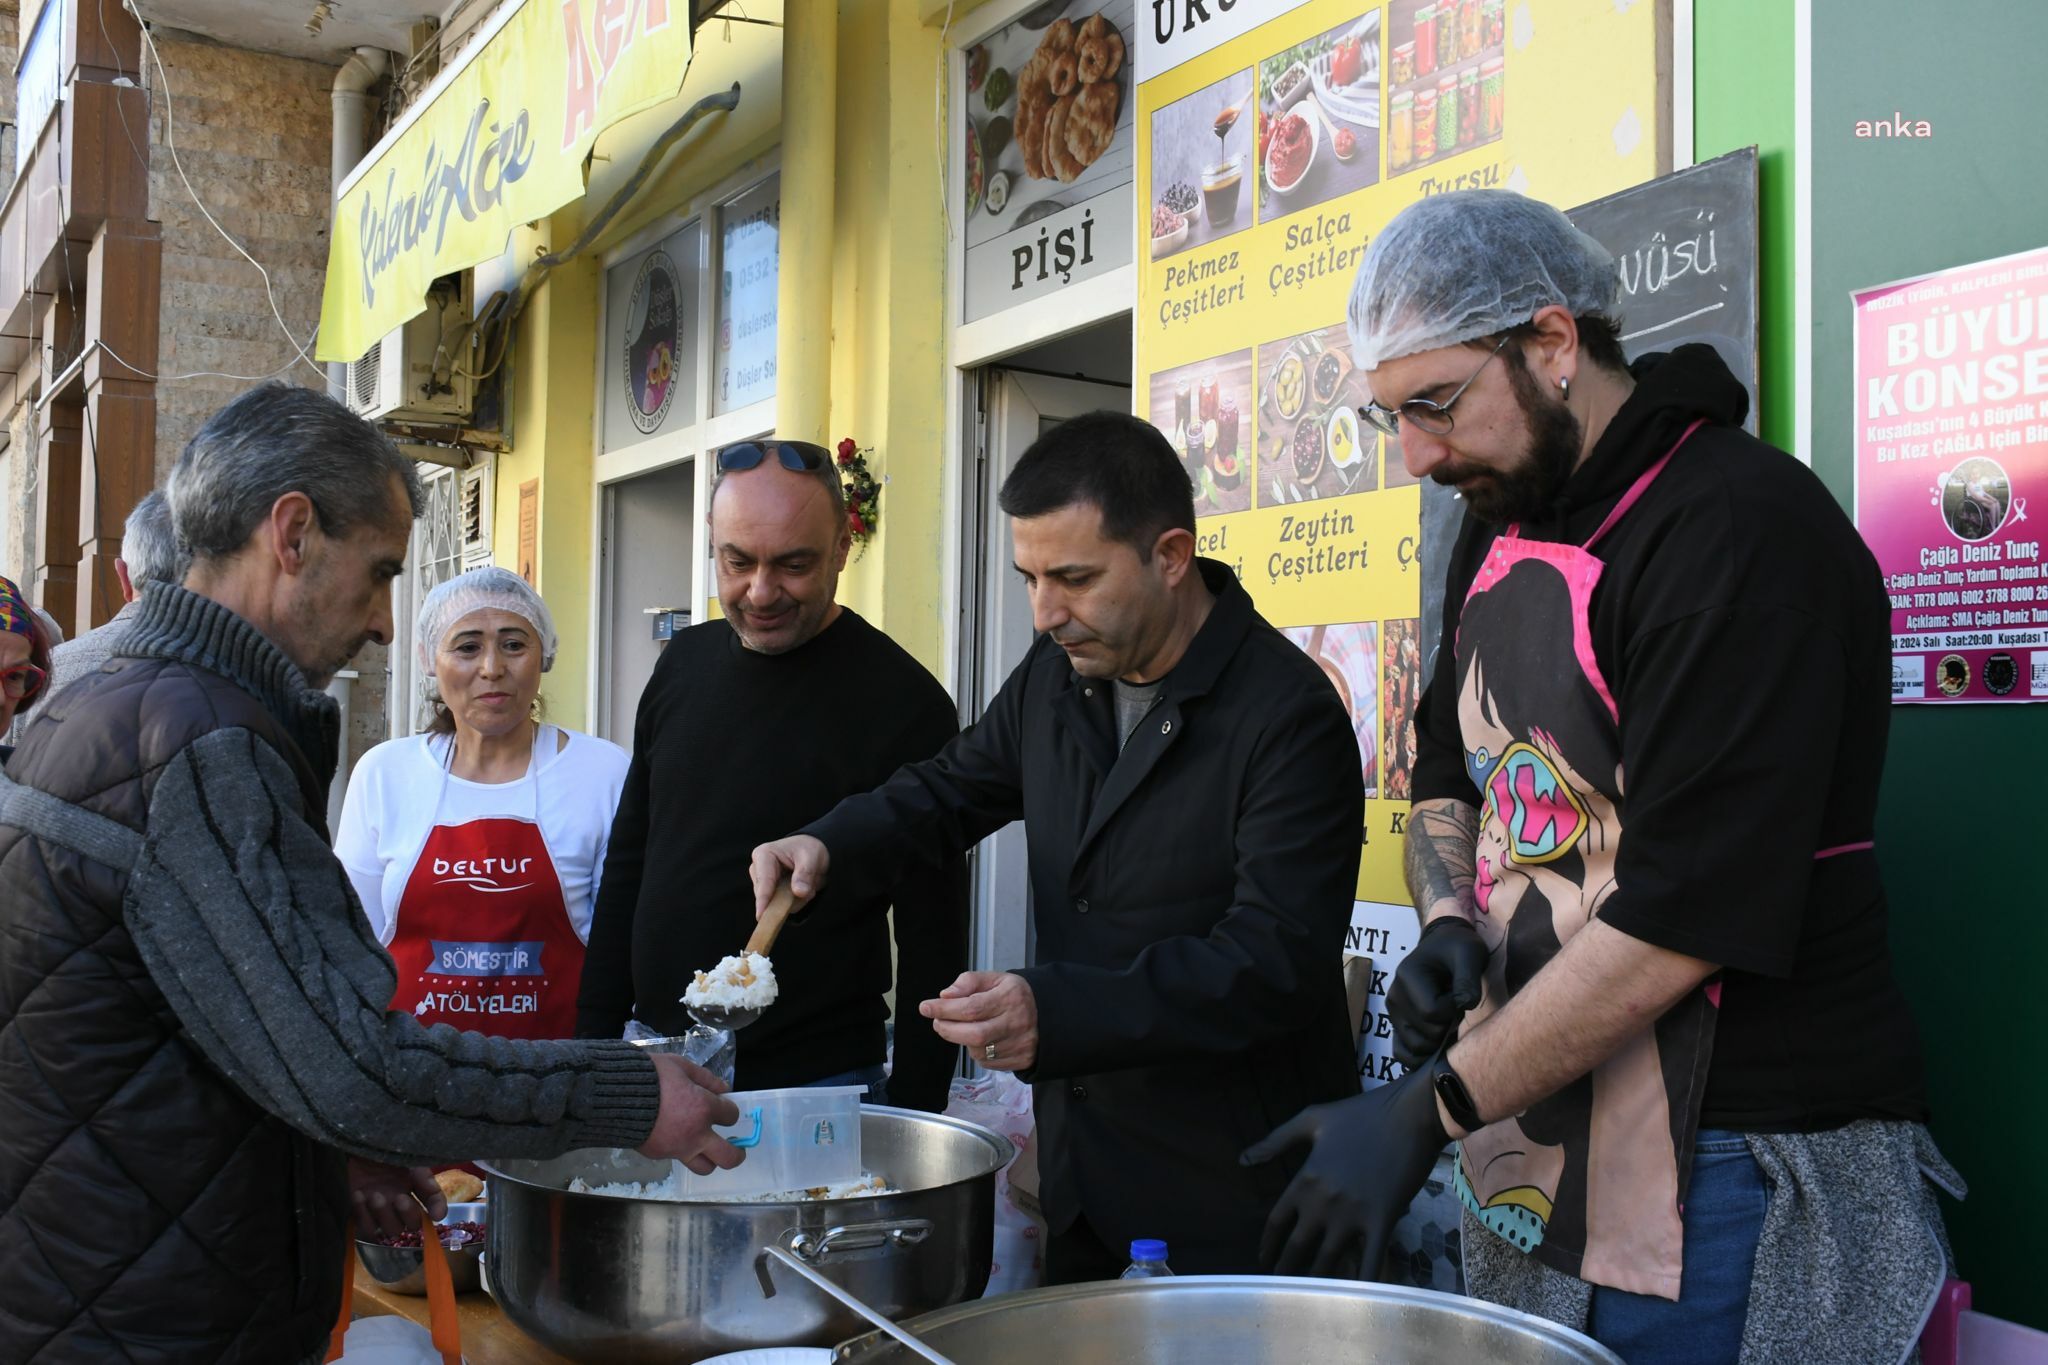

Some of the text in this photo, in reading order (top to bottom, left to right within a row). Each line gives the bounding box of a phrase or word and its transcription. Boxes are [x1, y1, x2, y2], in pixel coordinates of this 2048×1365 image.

[1285, 211, 1352, 252] Salça
[1011, 208, 1095, 290] PİŞİ
[740, 256, 769, 288] 0532
[1164, 250, 1239, 292] Pekmez
[1268, 235, 1368, 296] Çeşitleri
[1159, 275, 1246, 329] Çeşitleri
[1867, 416, 1965, 443] Kuşadası'nın
[1969, 411, 1979, 428] 4
[1984, 403, 2035, 428] Büyük
[1877, 446, 1896, 463] Bu
[1901, 442, 1929, 460] Kez
[1933, 433, 1985, 459] ÇAĞLA
[1280, 508, 1355, 547] Zeytin
[1267, 541, 1369, 585] Çeşitleri
[1920, 540, 2039, 571] Çağla Deniz Tunç
[1891, 574, 1915, 592] Çağla
[1917, 572, 1941, 586] Deniz
[1943, 570, 1963, 587] Tunç
[1966, 568, 1997, 583] Yardım
[2000, 564, 2039, 582] Toplama
[1914, 593, 1936, 608] TR78
[1937, 591, 1959, 606] 0004
[1961, 589, 1984, 605] 6002
[1985, 588, 2008, 603] 3788
[2010, 586, 2034, 602] 8000
[1906, 614, 1950, 631] Açıklama:
[1952, 612, 1973, 627] SMA
[1975, 610, 2000, 629] Çağla
[2003, 609, 2029, 624] Deniz
[1900, 637, 1921, 649] 2024
[1923, 636, 1940, 648] Salı
[1946, 633, 1992, 647] Saat:20:00
[1998, 631, 2041, 647] Kuşadası
[442, 947, 529, 970] SÖMESTİR
[424, 991, 538, 1014] ATÖLYELERİ
